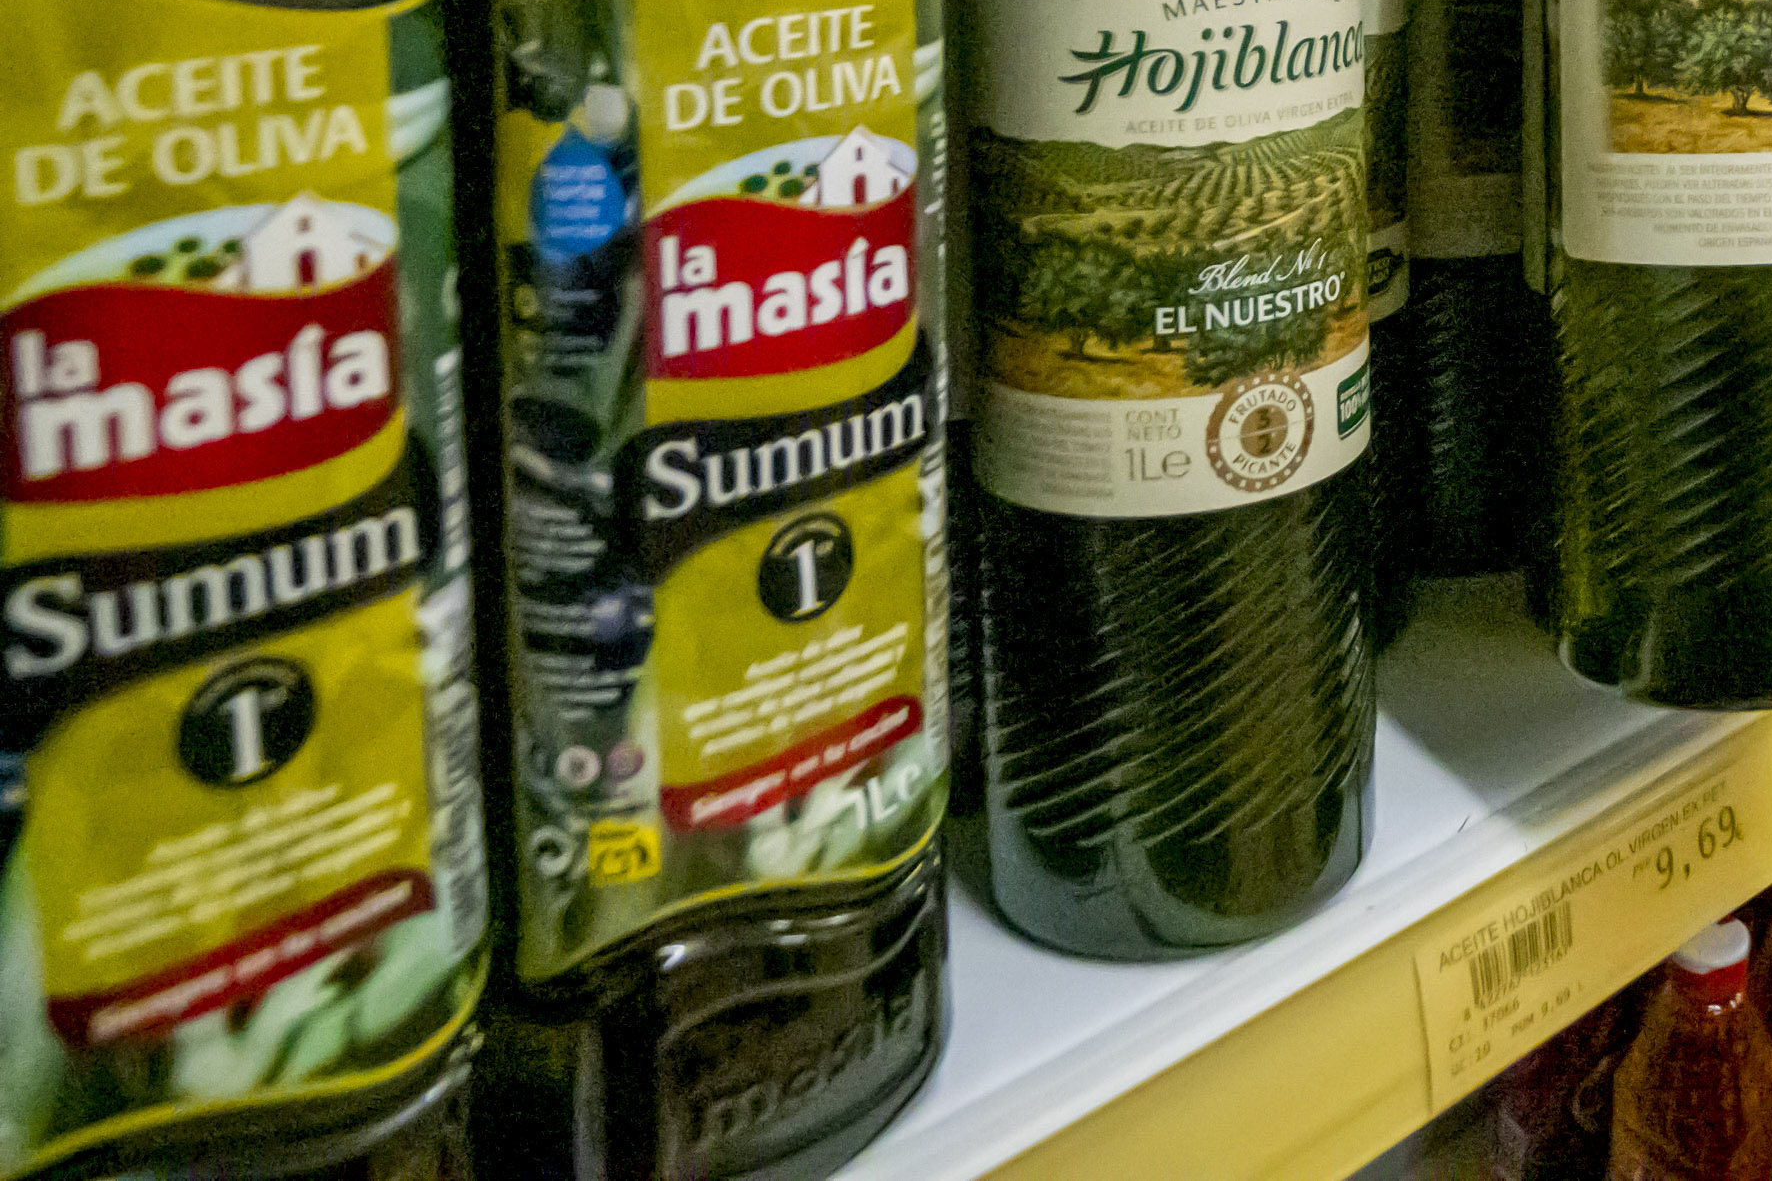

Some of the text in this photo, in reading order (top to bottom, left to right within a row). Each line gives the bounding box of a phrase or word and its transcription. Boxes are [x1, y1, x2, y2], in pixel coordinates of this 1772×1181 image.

[698, 4, 875, 71] ACEITE
[1058, 19, 1363, 115] Hojiblanca
[56, 44, 325, 133] ACEITE
[665, 55, 901, 132] DE OLIVA
[1125, 119, 1186, 134] ACEITE
[1195, 116, 1217, 131] DE
[1224, 110, 1271, 128] OLIVA
[1276, 101, 1324, 123] VIRGEN
[14, 105, 370, 206] DE OLIVA
[659, 235, 716, 289] la
[1188, 254, 1283, 294] Blend
[660, 236, 910, 359] masía
[1156, 272, 1343, 335] EL NUESTRO
[12, 328, 98, 397] la
[20, 323, 391, 482] masía
[1125, 408, 1179, 423] CONT
[1127, 424, 1182, 441] NETO
[1229, 388, 1297, 425] FRUTADO
[644, 392, 926, 521] Sumum
[1233, 441, 1297, 474] PICANTE
[3, 505, 420, 681] Sumum
[1438, 922, 1500, 972] ACEITE
[1503, 862, 1604, 934] HOJIBLANCA
[1629, 811, 1679, 854] VIRGEN
